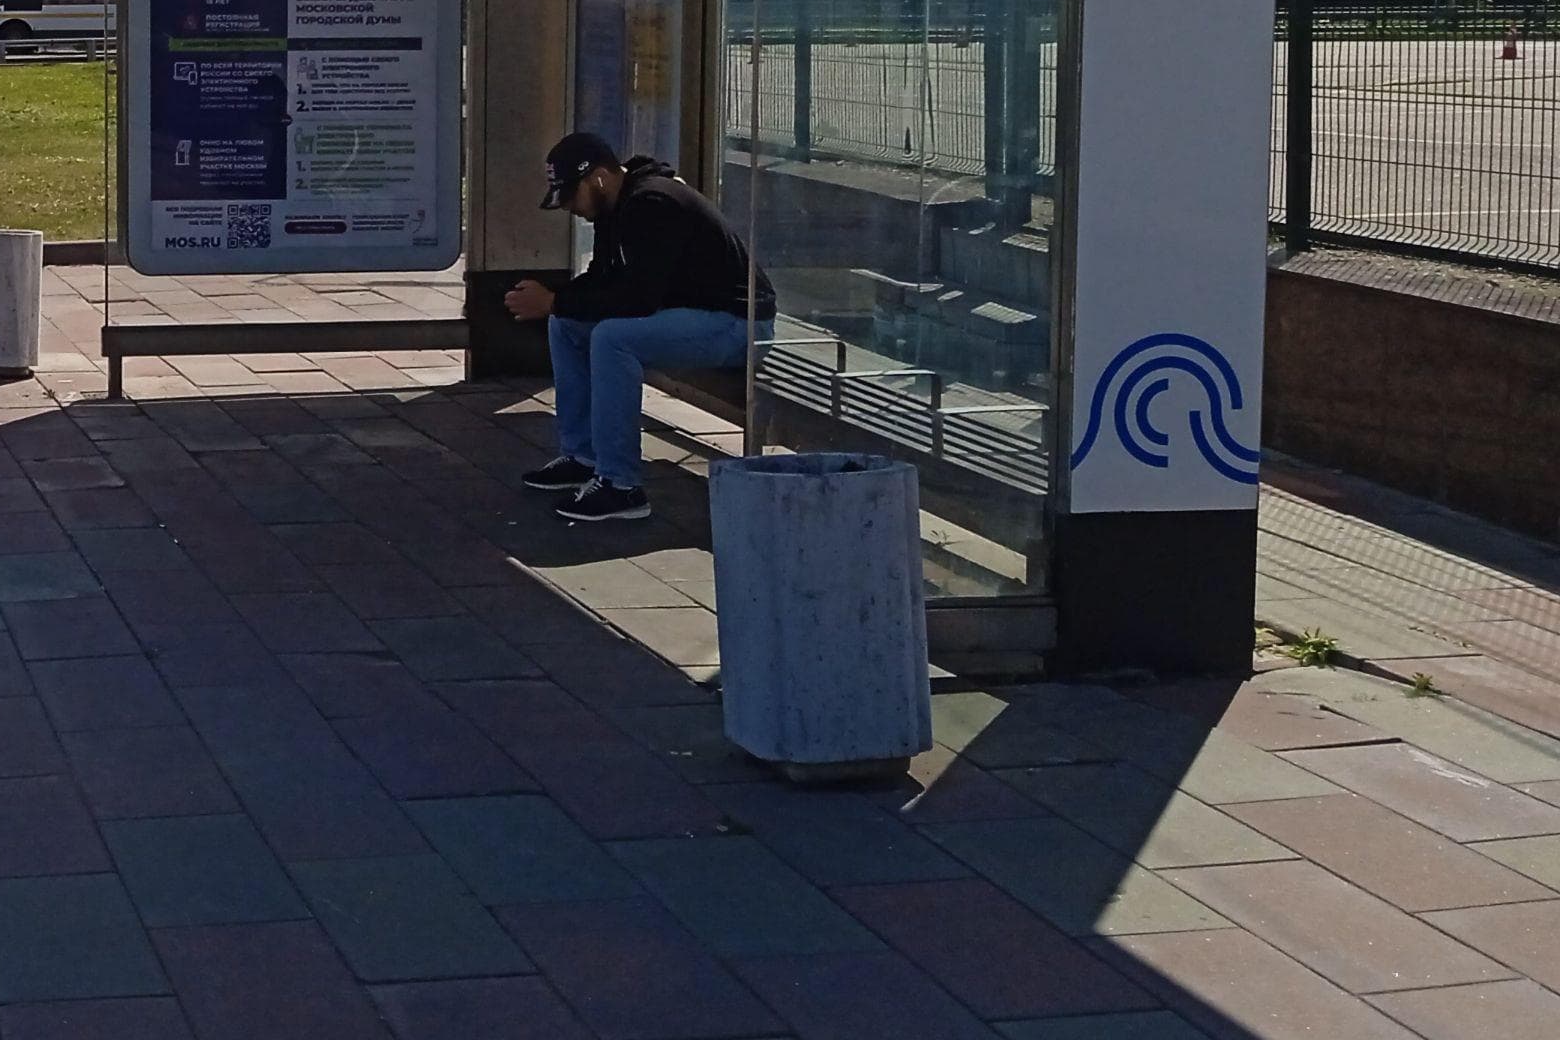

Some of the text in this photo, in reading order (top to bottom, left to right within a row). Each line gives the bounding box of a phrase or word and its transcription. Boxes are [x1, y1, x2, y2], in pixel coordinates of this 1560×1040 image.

[296, 2, 374, 13] МОСКОВСКОЙ
[296, 14, 402, 25] ГОРОДСКОЙ ДУМЫ
[165, 237, 221, 248] MOS.RU
